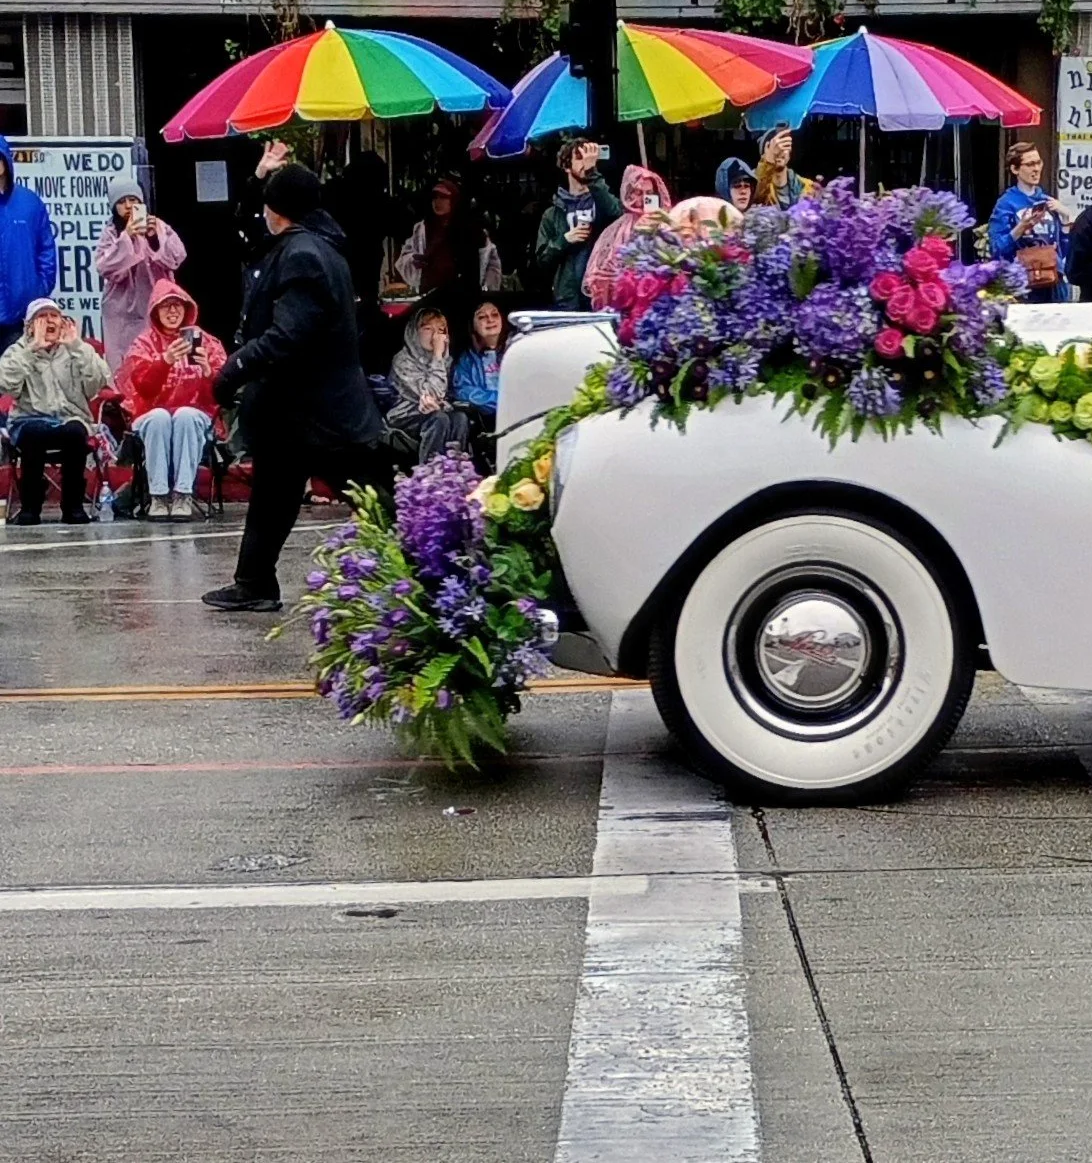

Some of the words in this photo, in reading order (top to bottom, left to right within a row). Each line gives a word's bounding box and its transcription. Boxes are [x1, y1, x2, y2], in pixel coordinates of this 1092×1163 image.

[62, 153, 92, 171] WE
[97, 153, 125, 172] DO
[34, 176, 66, 198] MOVE
[70, 176, 115, 198] FORWA
[80, 297, 100, 311] WE
